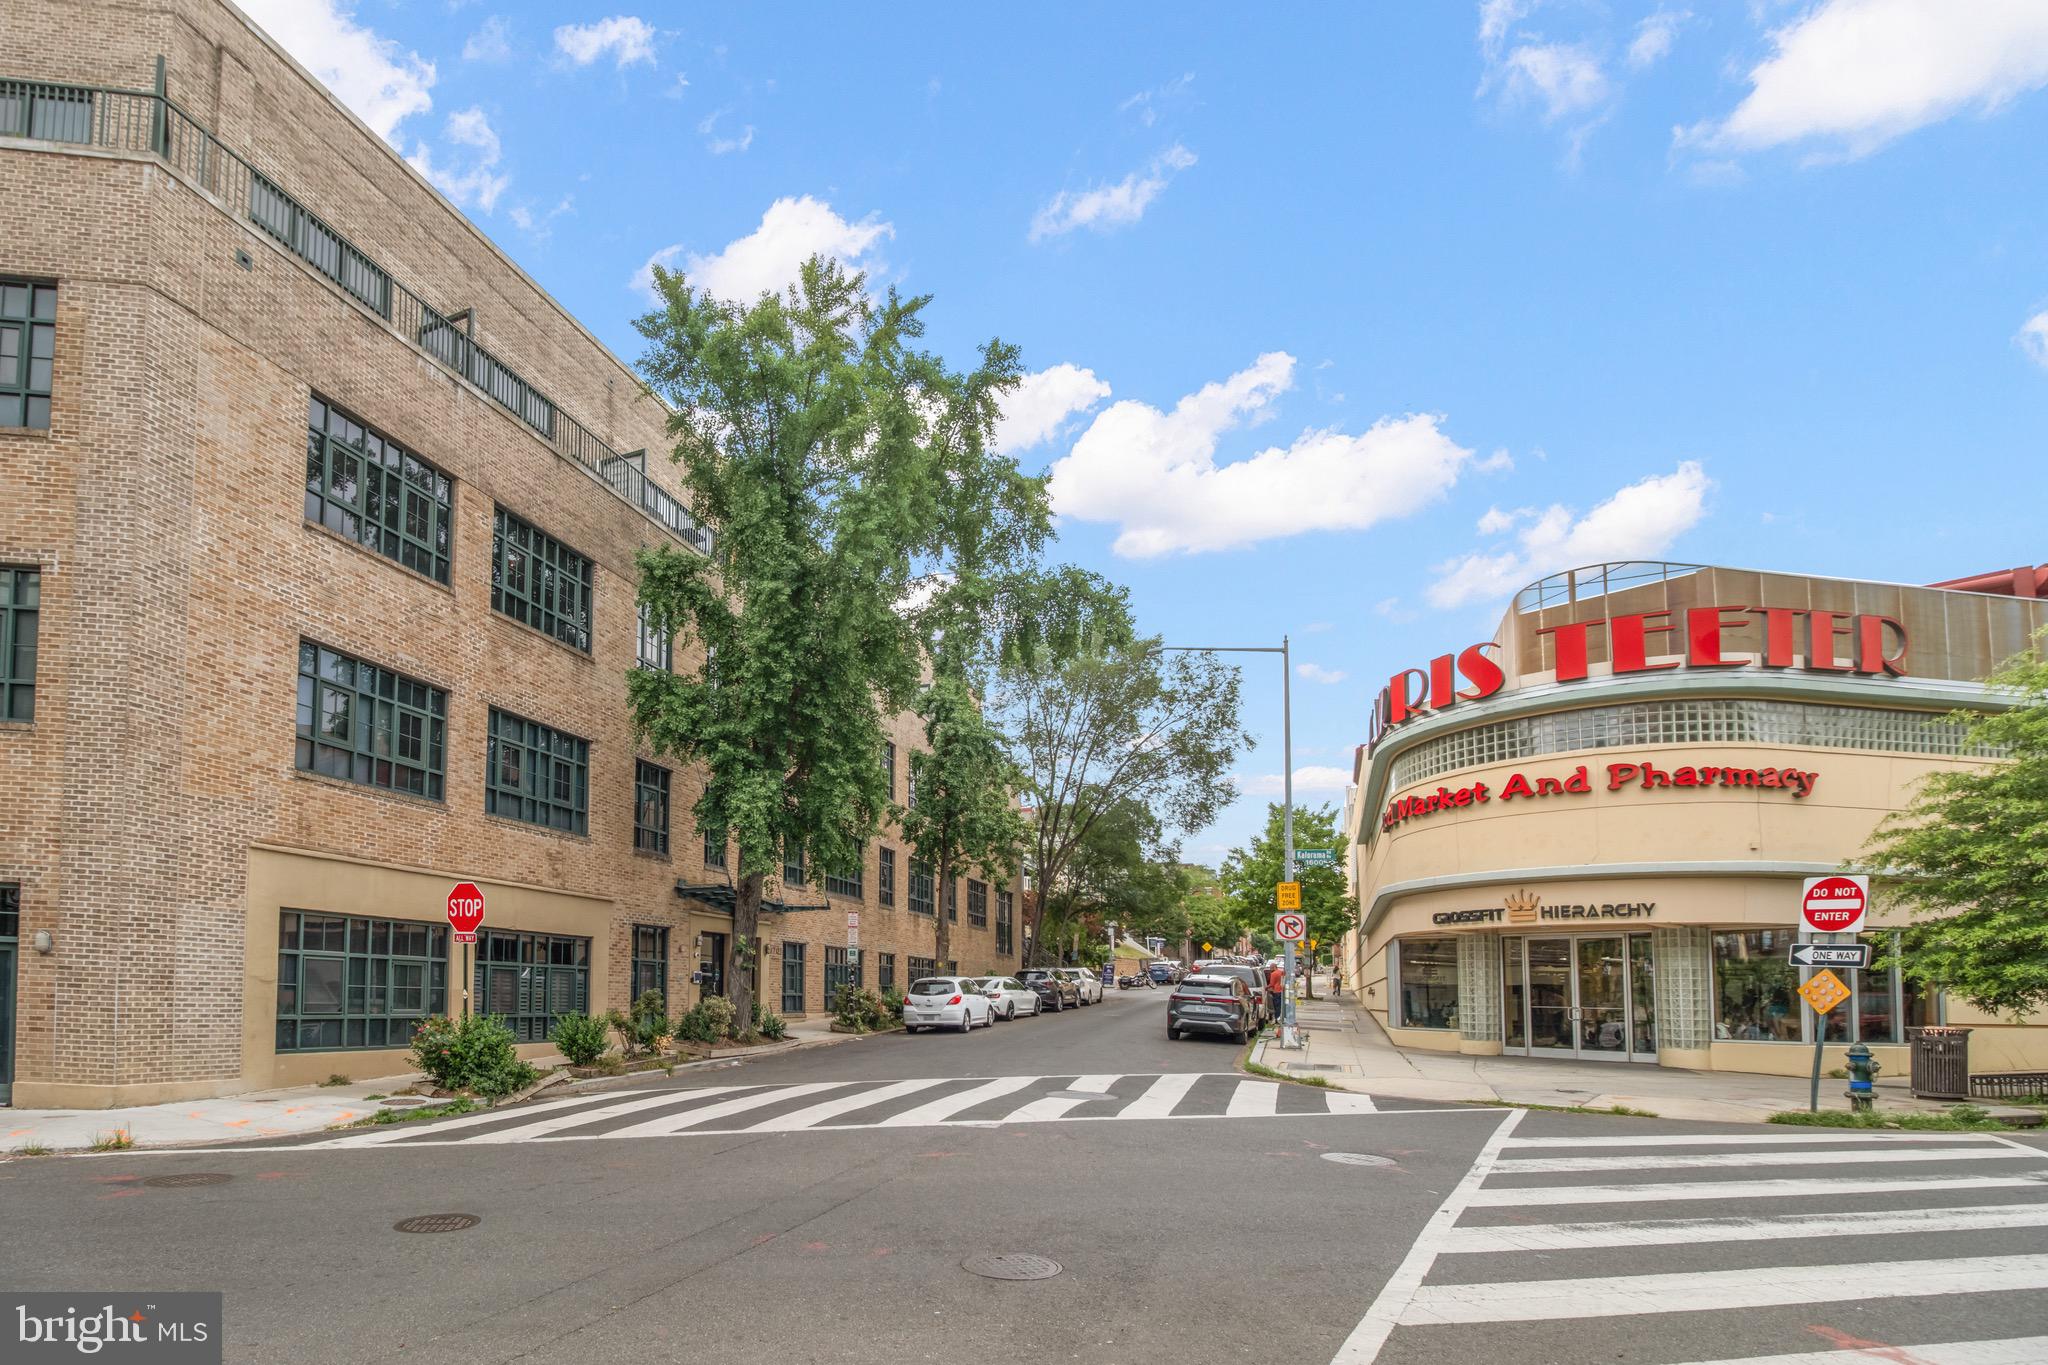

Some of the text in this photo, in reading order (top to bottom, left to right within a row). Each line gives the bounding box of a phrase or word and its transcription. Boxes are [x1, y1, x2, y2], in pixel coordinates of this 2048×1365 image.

[1536, 605, 1909, 682] TEETER
[1397, 781, 1490, 820] Market
[1499, 765, 1592, 800] And
[1607, 762, 1819, 797] Pharmacy
[1297, 851, 1326, 859] Kalorama
[1813, 887, 1857, 898] DO NOT
[450, 898, 482, 917] STOP
[1541, 903, 1656, 919] HIERARCHY
[1814, 911, 1850, 921] ENTER
[1812, 951, 1857, 960] ONE WAY
